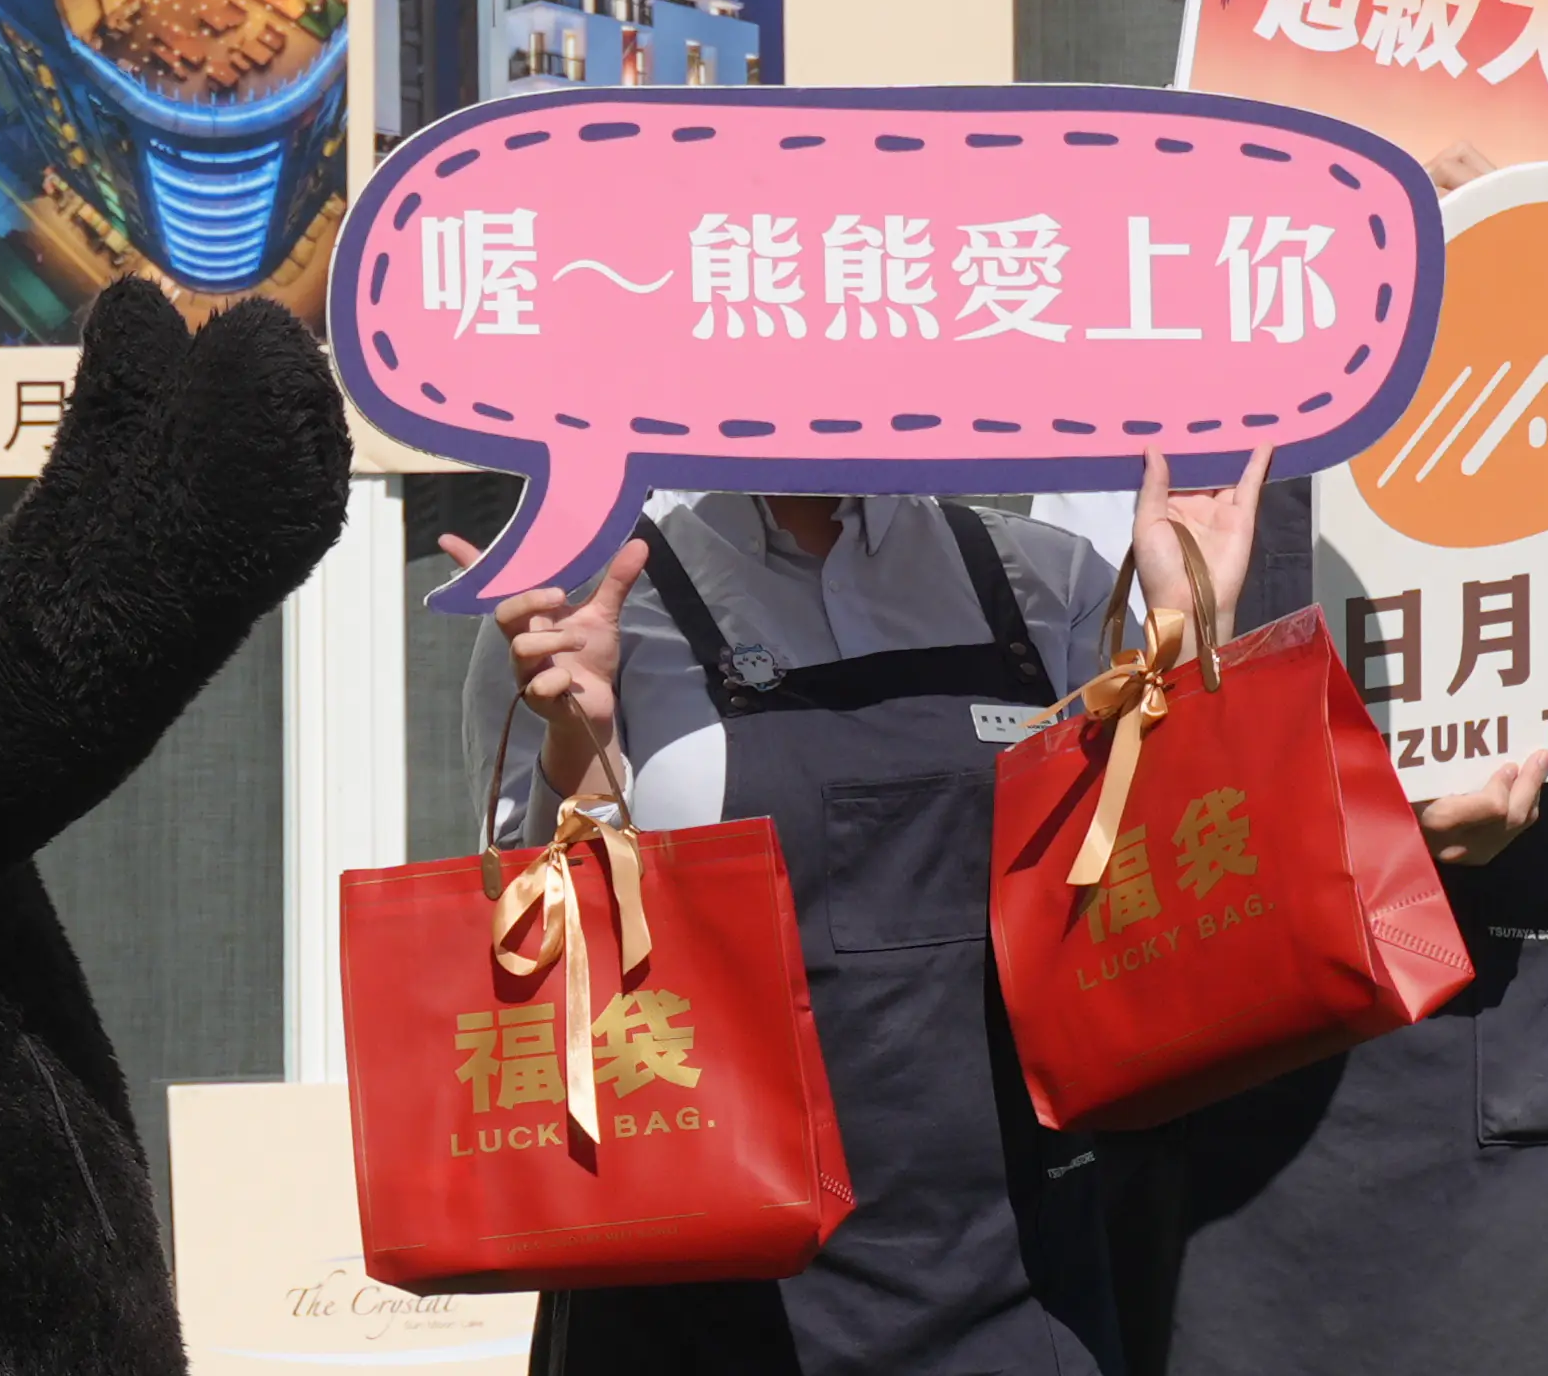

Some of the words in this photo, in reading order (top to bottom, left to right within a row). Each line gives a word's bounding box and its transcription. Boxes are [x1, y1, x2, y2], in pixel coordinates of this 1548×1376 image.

[1381, 715, 1509, 770] ZUKI
[1080, 786, 1258, 945] 福袋
[1076, 926, 1180, 991] LUCKY
[1198, 893, 1276, 940] BAG.
[455, 989, 702, 1113] 福袋
[450, 1121, 566, 1158] LUCK
[614, 1106, 716, 1139] BAG.
[286, 1269, 347, 1317] The
[351, 1285, 456, 1341] Crystal
